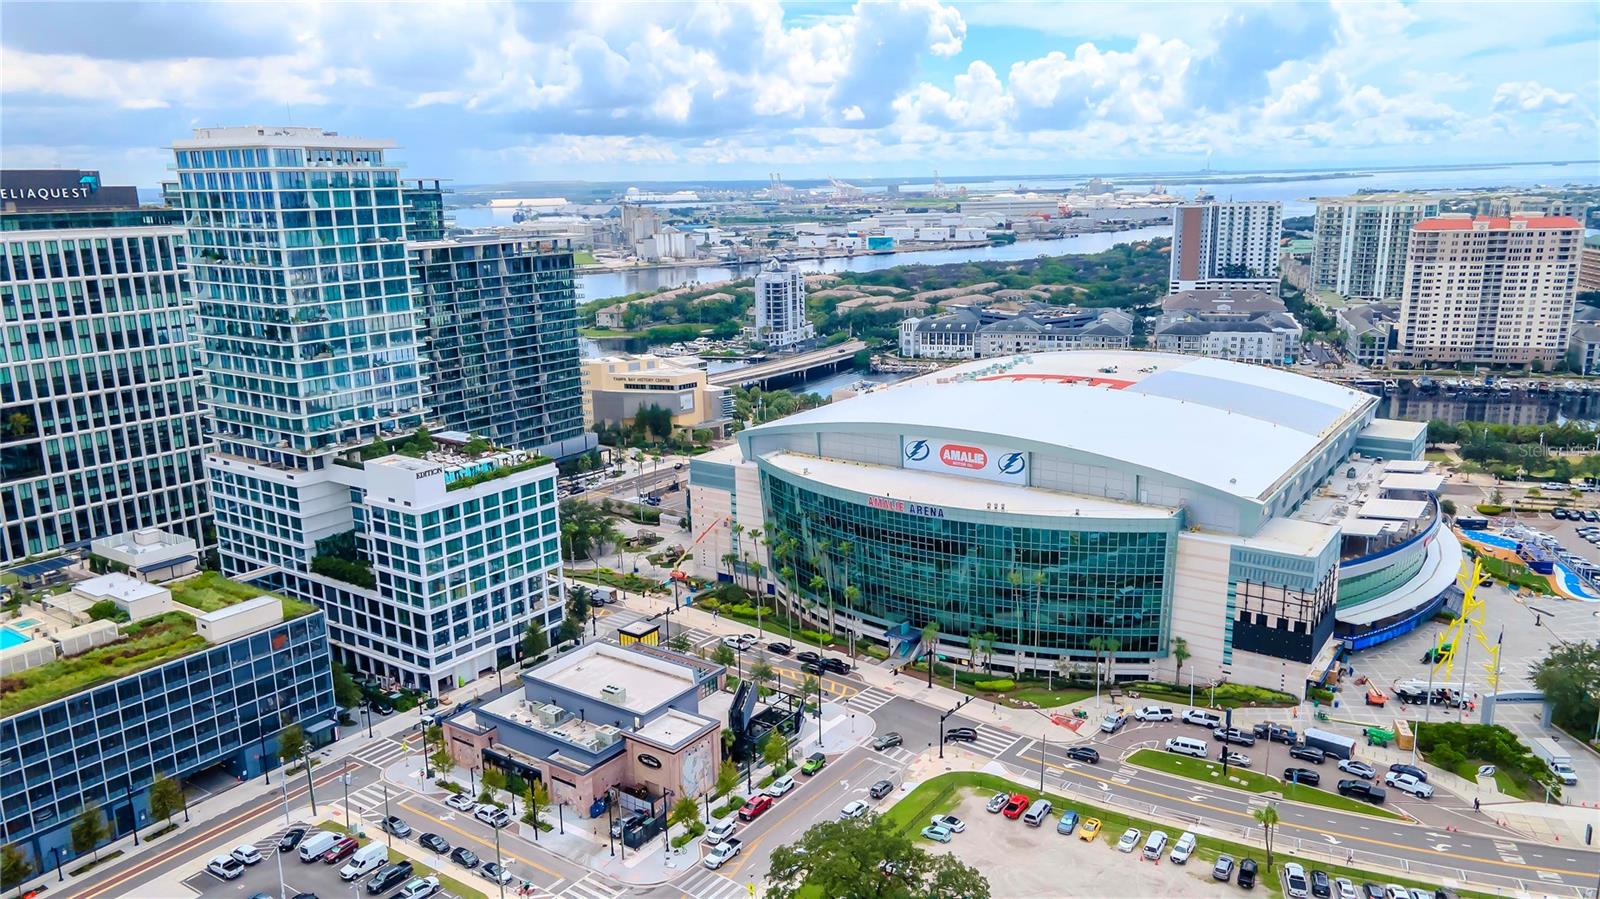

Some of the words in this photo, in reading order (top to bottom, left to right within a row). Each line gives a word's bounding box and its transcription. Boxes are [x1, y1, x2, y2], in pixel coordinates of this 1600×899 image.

[943, 449, 984, 464] AMALIE
[416, 467, 442, 479] EDITION
[868, 496, 904, 512] AMALIE
[910, 504, 944, 518] ARENA
